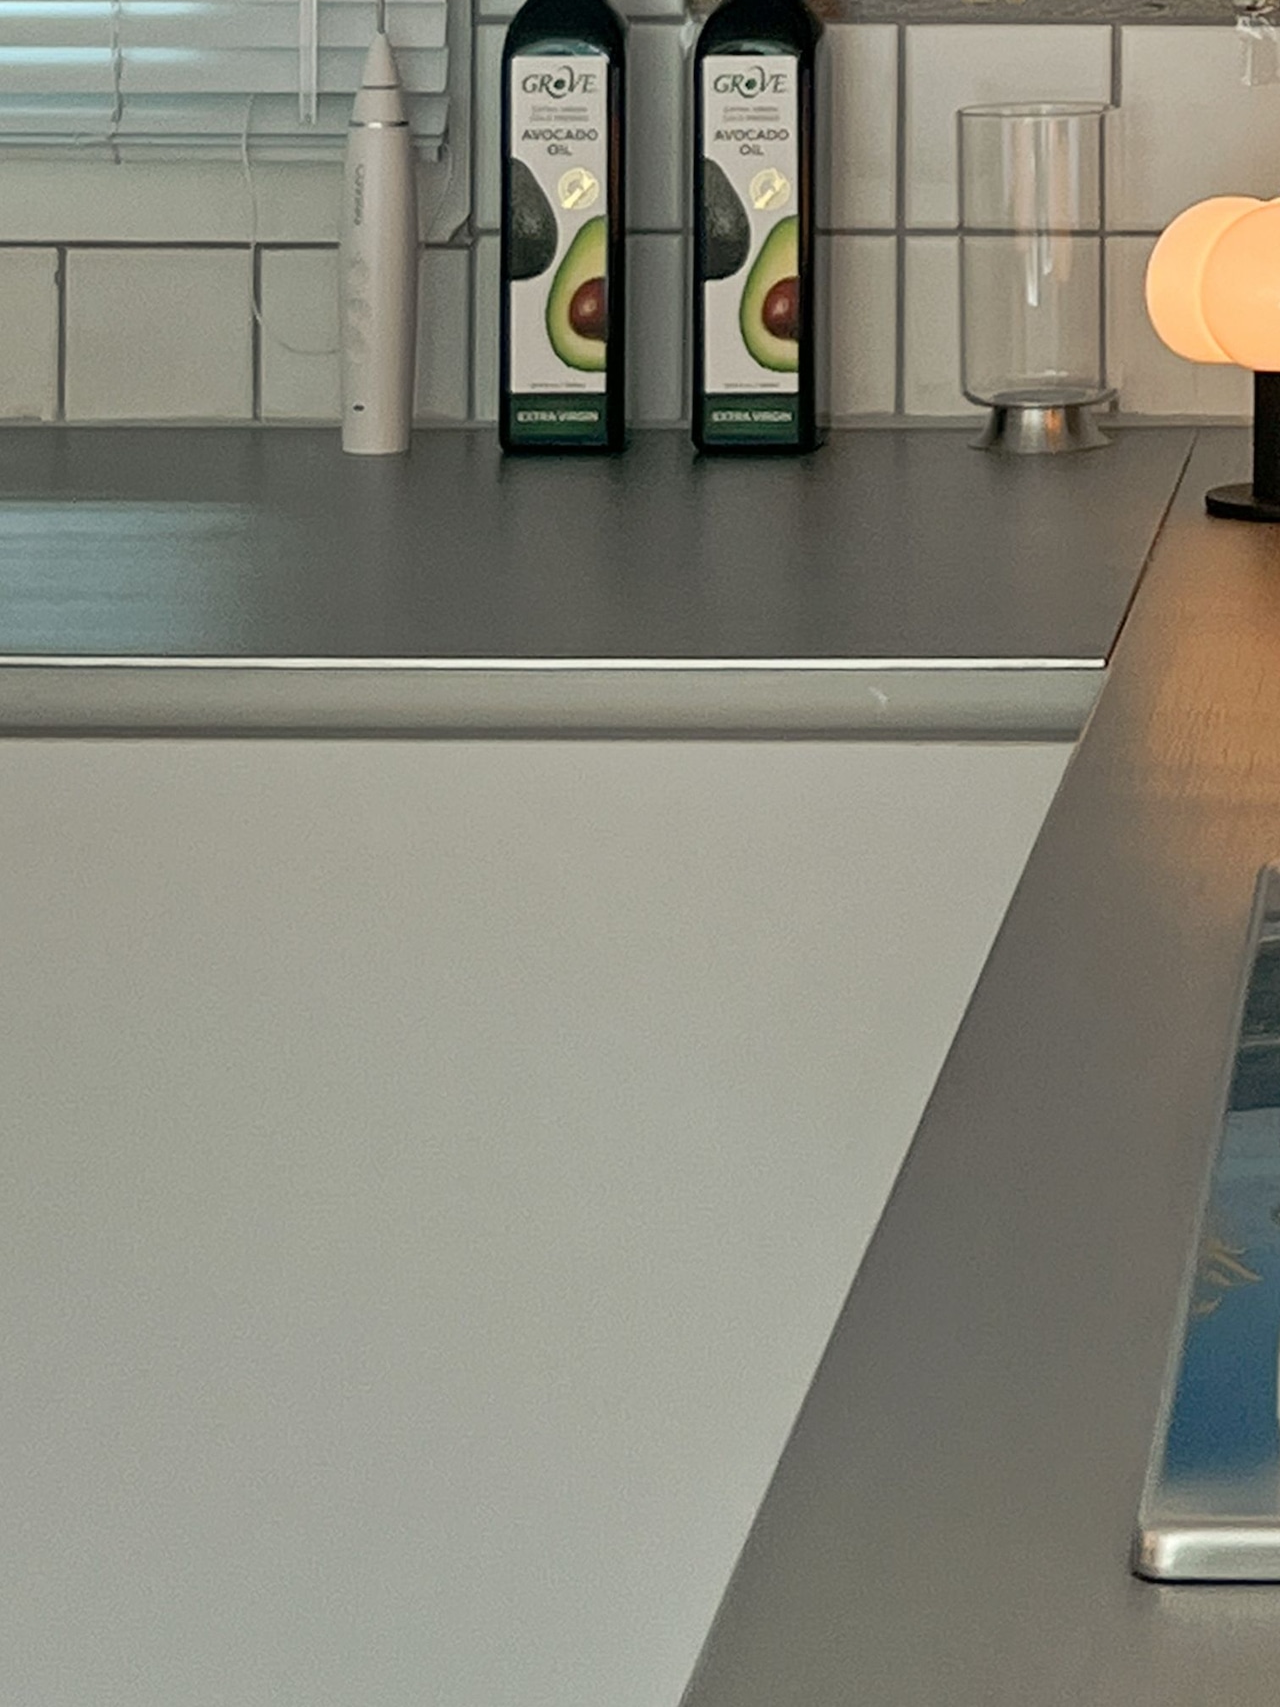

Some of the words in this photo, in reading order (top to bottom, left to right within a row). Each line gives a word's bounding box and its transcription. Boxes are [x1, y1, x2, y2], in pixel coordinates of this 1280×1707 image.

[521, 65, 597, 99] GROVE
[713, 65, 787, 99] GROVE
[521, 128, 599, 142] AVOCADO
[713, 128, 790, 142] AVOCADO
[547, 143, 573, 156] OIL
[739, 143, 765, 156] OIL
[516, 410, 557, 423] EXTRA
[558, 410, 599, 423] VIRGIN
[711, 410, 751, 423] EXTRA
[752, 410, 793, 423] VIRGIN
